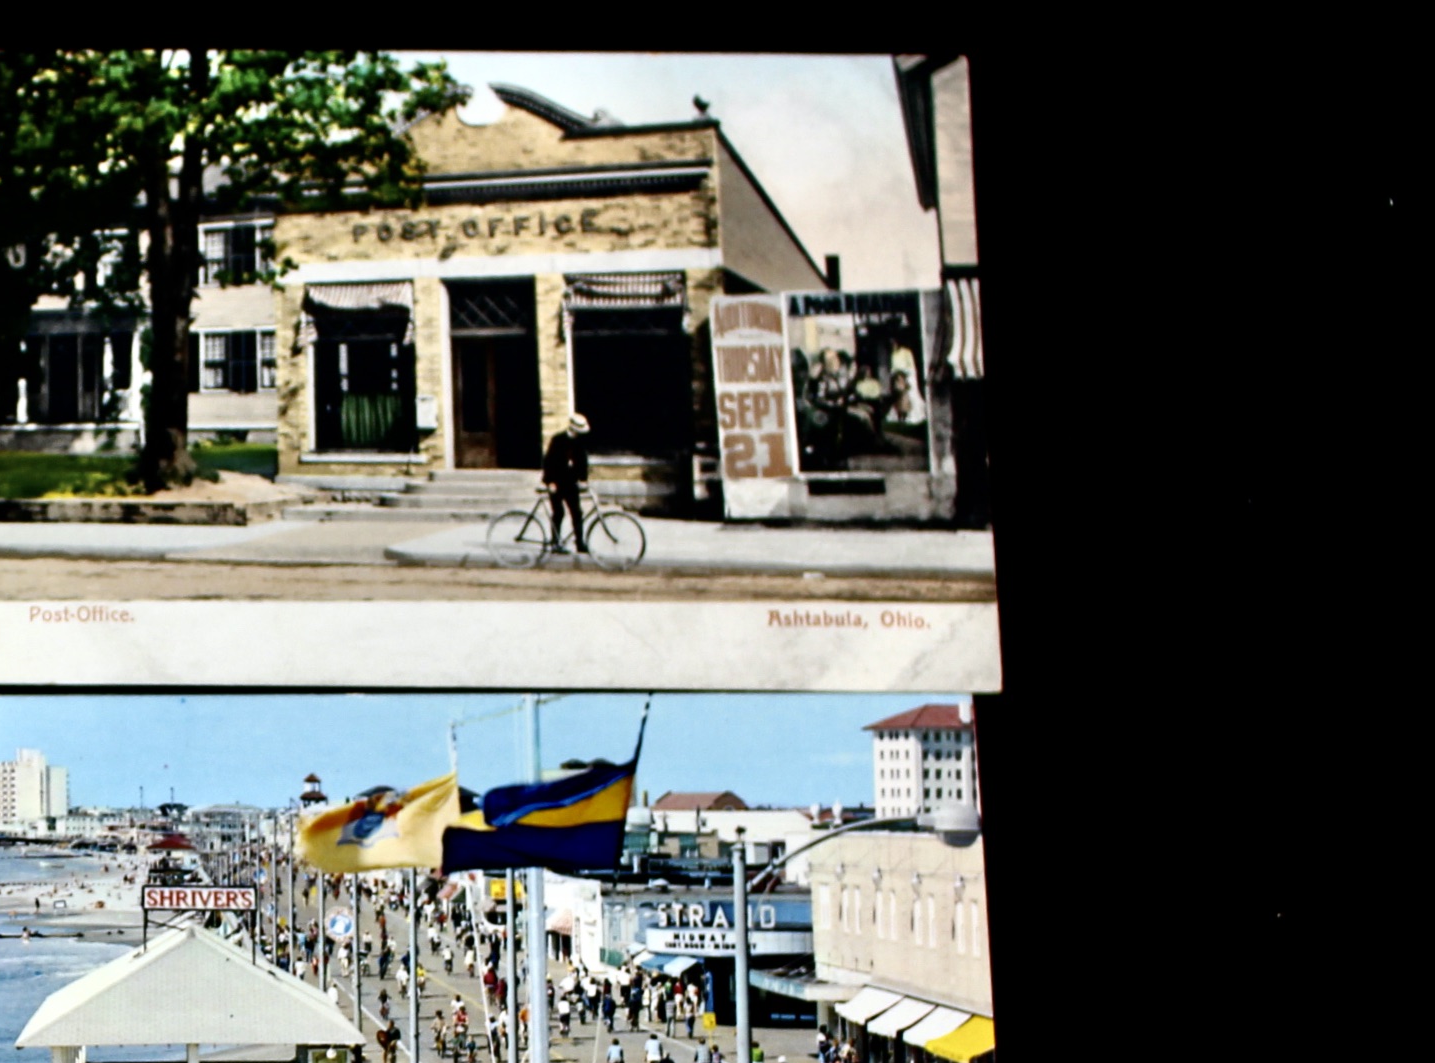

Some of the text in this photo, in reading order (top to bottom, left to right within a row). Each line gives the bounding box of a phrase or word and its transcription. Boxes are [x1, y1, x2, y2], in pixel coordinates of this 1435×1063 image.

[352, 208, 599, 243] POST OFFICE
[718, 390, 786, 430] SEPT
[723, 433, 792, 478] 21
[29, 605, 135, 622] Post-Office.
[768, 609, 931, 629] Ashtabula, Ohio.
[146, 888, 253, 908] SHRIVER'S
[657, 901, 776, 929] STRAD
